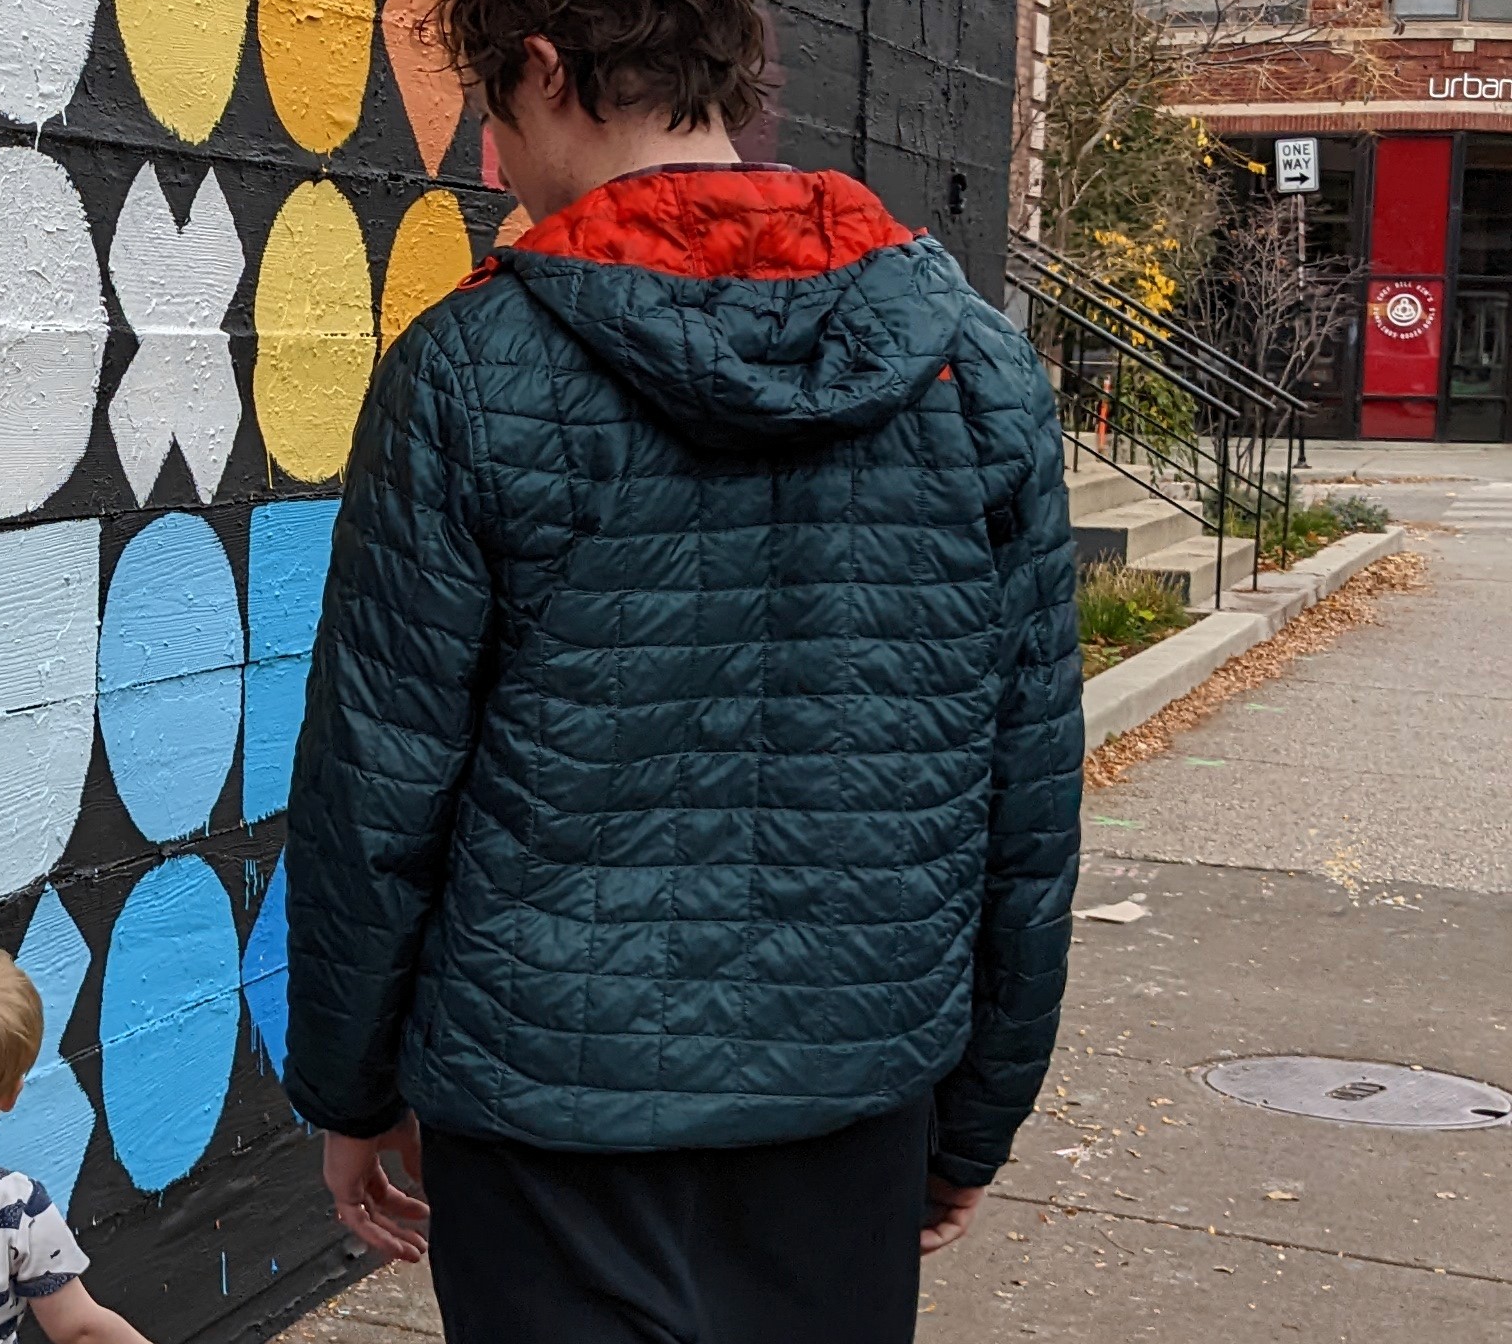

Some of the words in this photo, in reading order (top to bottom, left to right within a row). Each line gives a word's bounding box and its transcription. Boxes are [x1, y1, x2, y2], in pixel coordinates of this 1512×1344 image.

[1429, 72, 1512, 99] urban
[1282, 143, 1311, 157] ONE
[1282, 157, 1312, 171] WAY
